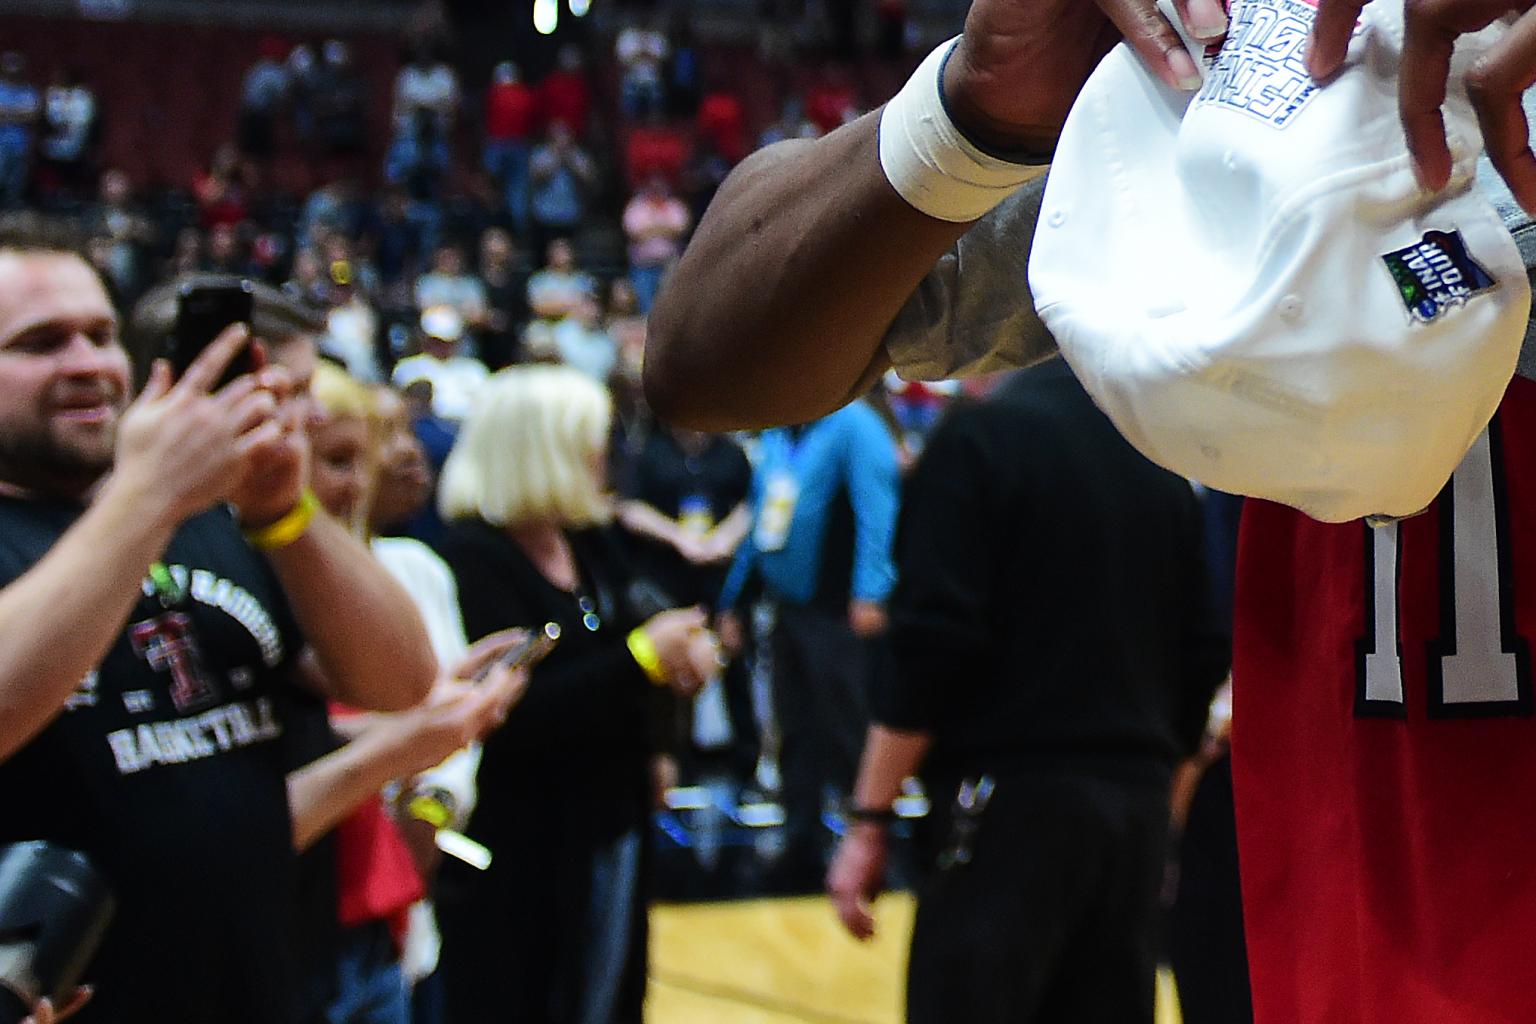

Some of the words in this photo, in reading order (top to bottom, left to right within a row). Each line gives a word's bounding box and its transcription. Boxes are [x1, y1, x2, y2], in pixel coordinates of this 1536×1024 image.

[1401, 249, 1450, 304] FINAL
[1419, 242, 1471, 298] FOUR
[1354, 411, 1535, 720] 11
